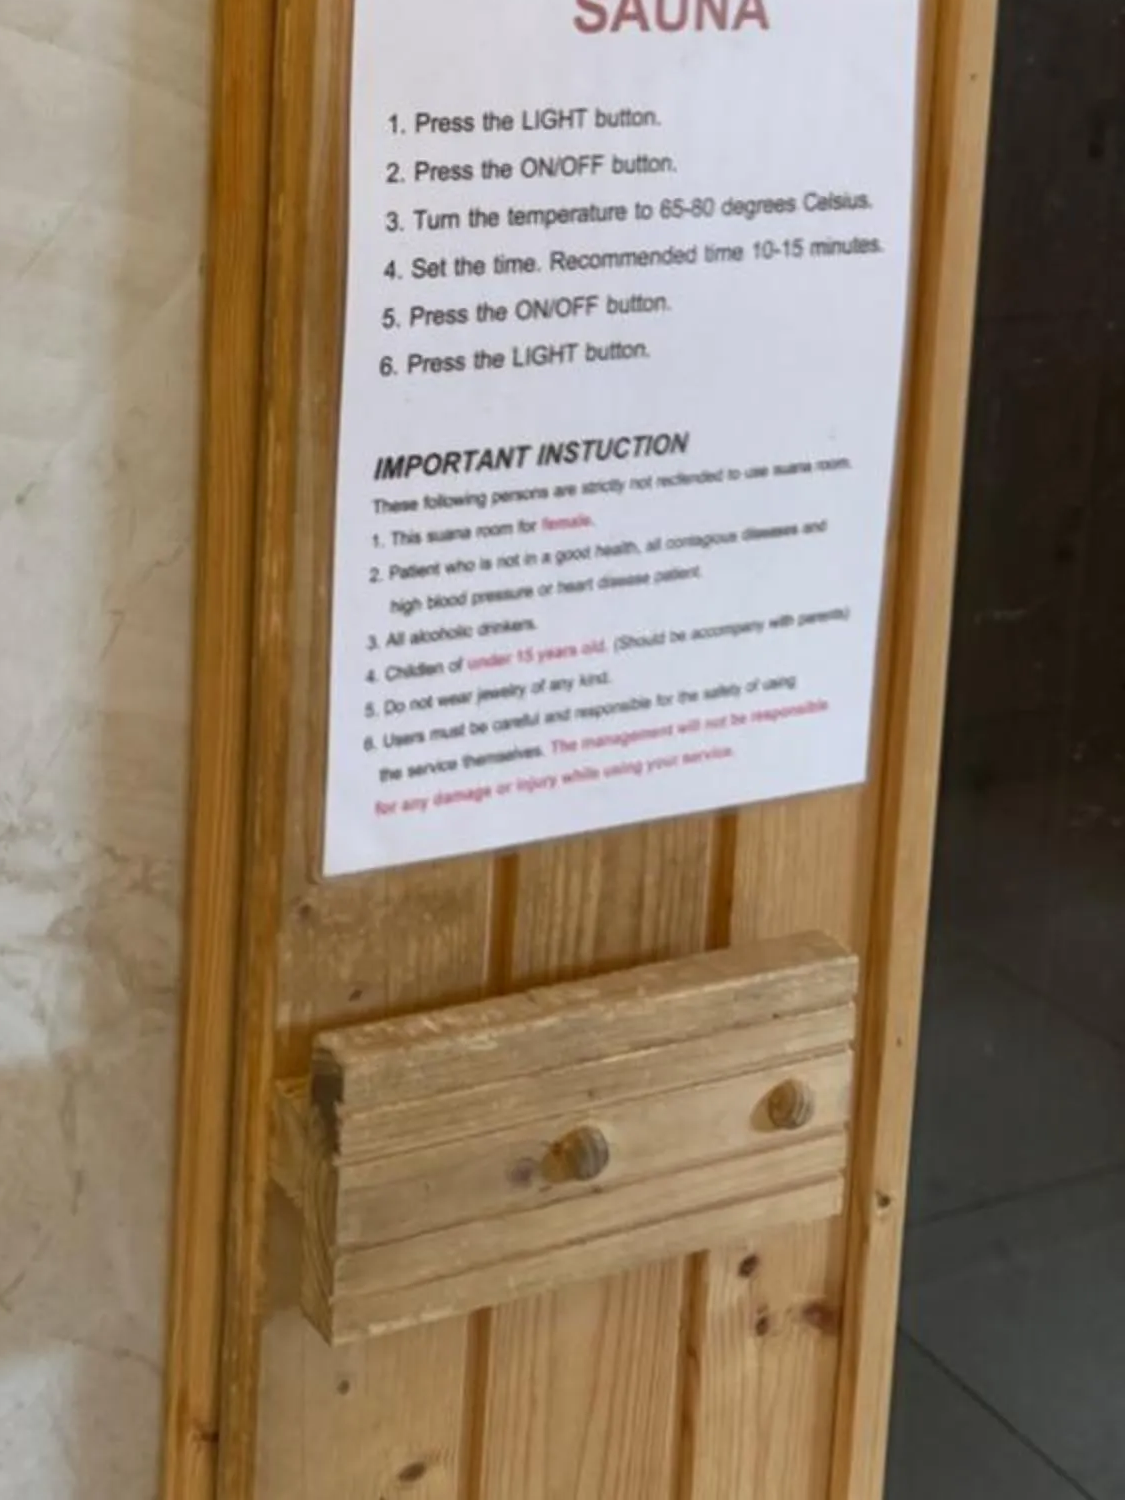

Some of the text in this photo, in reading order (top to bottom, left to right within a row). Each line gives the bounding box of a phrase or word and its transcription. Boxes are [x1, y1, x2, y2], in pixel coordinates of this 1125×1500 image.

[388, 107, 661, 134] 1. Press the LIGHT button.
[385, 153, 677, 184] 2. Press the ON/OFF button.
[385, 210, 404, 232] 3.
[412, 208, 461, 230] Turn
[467, 207, 500, 228] the
[507, 203, 628, 229] temperature
[634, 201, 654, 220] to
[720, 197, 798, 220] degrees
[802, 191, 873, 212] Celsius.
[383, 236, 884, 280] 4. Set the time. Recommended time 10-15 minutes.
[381, 294, 671, 330] 5. Press the ON/OFF button.
[379, 341, 650, 377] 6. Press the LIGHT button.
[373, 431, 689, 480] IMPORTANT INSTUCTION
[372, 498, 419, 514] These
[422, 492, 487, 510] following
[490, 487, 549, 506] persons
[552, 484, 577, 498] are
[581, 478, 625, 495] strictly
[629, 475, 652, 490] not
[727, 468, 741, 480] to
[744, 466, 769, 479] use
[368, 566, 383, 584] 2.
[388, 562, 441, 580] Patient
[444, 559, 476, 575] who
[478, 557, 493, 571] is
[496, 553, 520, 568] not
[522, 553, 538, 566] in
[540, 552, 552, 564] a
[554, 546, 591, 567] good
[645, 537, 662, 552] all
[665, 531, 738, 549] contagious
[741, 524, 799, 541] diseases
[801, 519, 827, 534] and
[372, 533, 384, 548] 1.
[390, 529, 423, 546] This
[475, 523, 514, 538] room
[516, 518, 538, 534] for
[389, 597, 423, 617] high
[426, 590, 468, 610] blood
[470, 586, 534, 607] pressure
[536, 583, 553, 597] or
[556, 577, 594, 594] heart
[596, 572, 651, 590] disease
[364, 668, 378, 684] 4.
[447, 656, 465, 673] of
[466, 653, 512, 671] under
[516, 647, 534, 663] 15
[536, 645, 578, 664] years
[613, 631, 666, 653] (Should
[669, 630, 687, 643] be
[689, 620, 765, 640] accompany
[768, 614, 795, 629] with
[366, 619, 537, 651] 3. All alcoholic drinkers.
[364, 701, 379, 718] 5.
[383, 698, 406, 716] Do
[409, 695, 433, 710] not
[436, 691, 473, 707] wear
[530, 678, 546, 694] of
[548, 678, 574, 692] any
[382, 731, 426, 748] Users
[429, 722, 466, 740] must
[468, 721, 489, 736] be
[543, 707, 571, 724] and
[574, 696, 652, 719] responsible
[655, 693, 673, 706] for
[677, 690, 699, 704] the
[745, 678, 760, 693] of
[761, 675, 796, 691] using
[378, 699, 829, 783] the service themselves. The management will not be responsible
[374, 800, 398, 817] for
[399, 797, 429, 813] any
[432, 785, 492, 807] damage
[495, 782, 514, 796] or
[514, 775, 557, 793] injury
[560, 766, 600, 784] while
[602, 760, 643, 778] using
[645, 755, 679, 773] your
